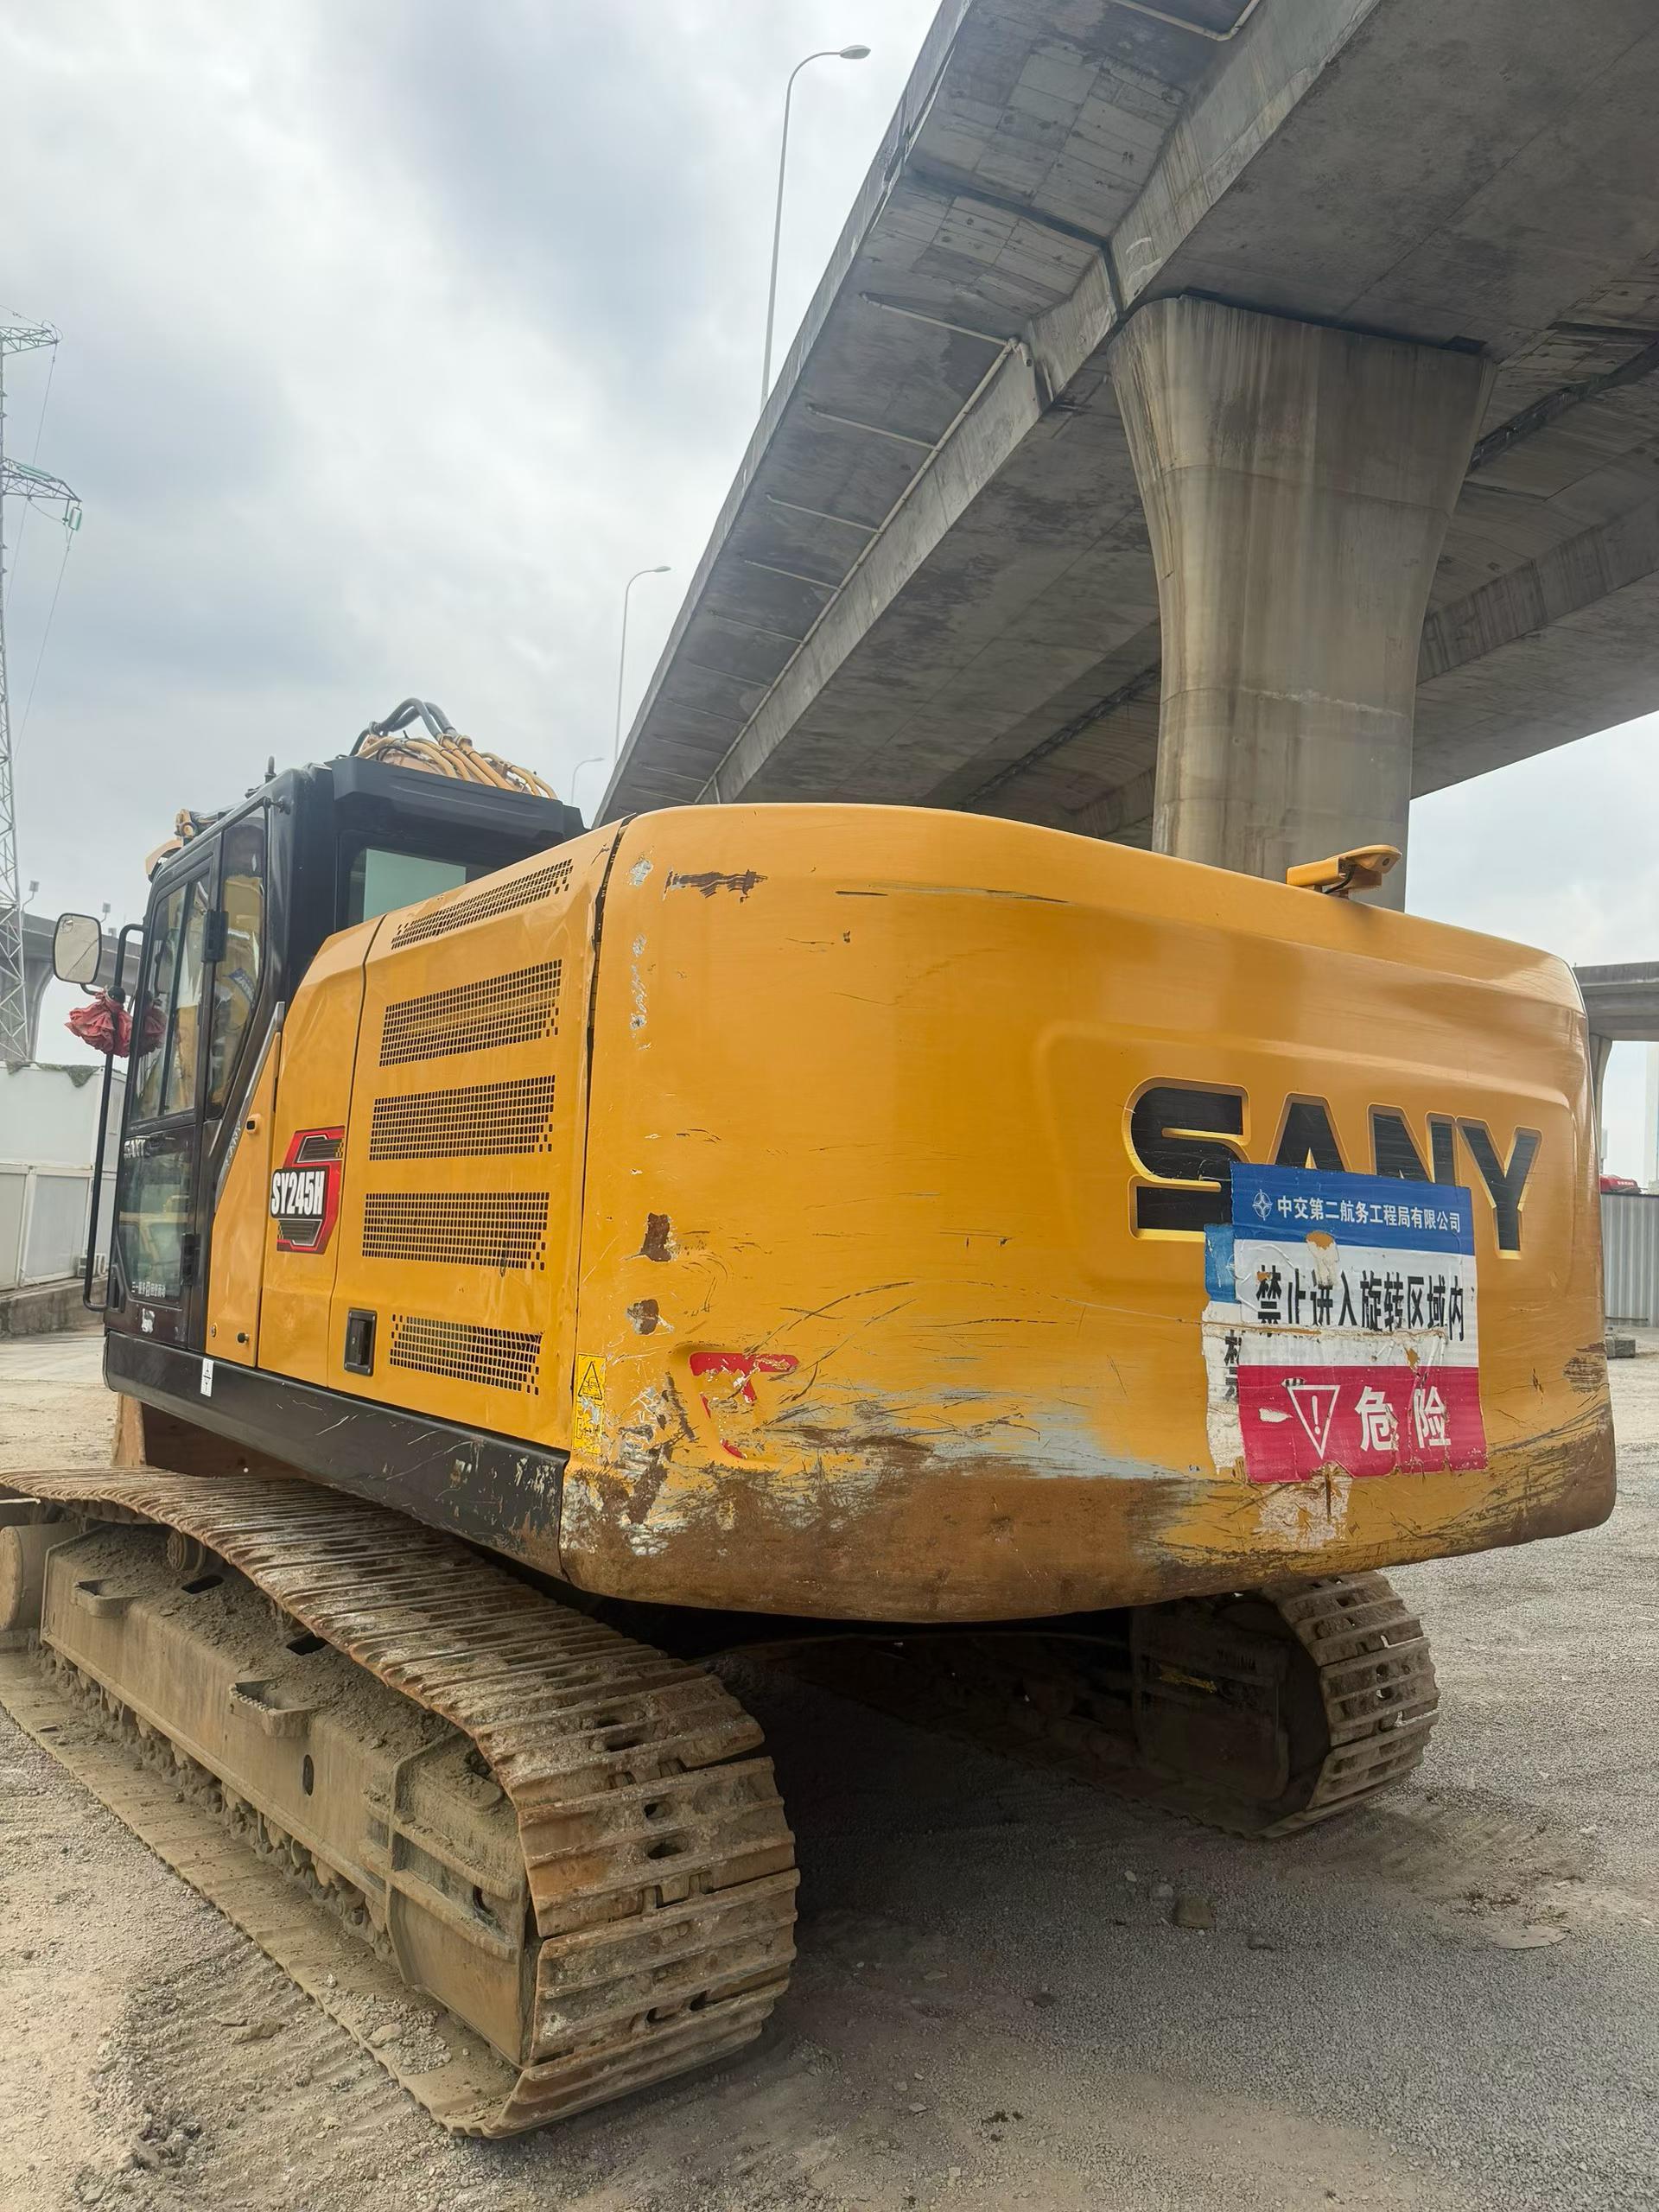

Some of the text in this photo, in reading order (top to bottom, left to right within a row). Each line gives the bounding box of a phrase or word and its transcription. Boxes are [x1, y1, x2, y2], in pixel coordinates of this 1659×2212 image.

[271, 1171, 326, 1216] SY245H
[1277, 1196, 1460, 1233] 中交第二航务工程局有限公司
[1255, 1264, 1465, 1341] 禁止进入旋转区域内
[1354, 1385, 1452, 1452] 危险
